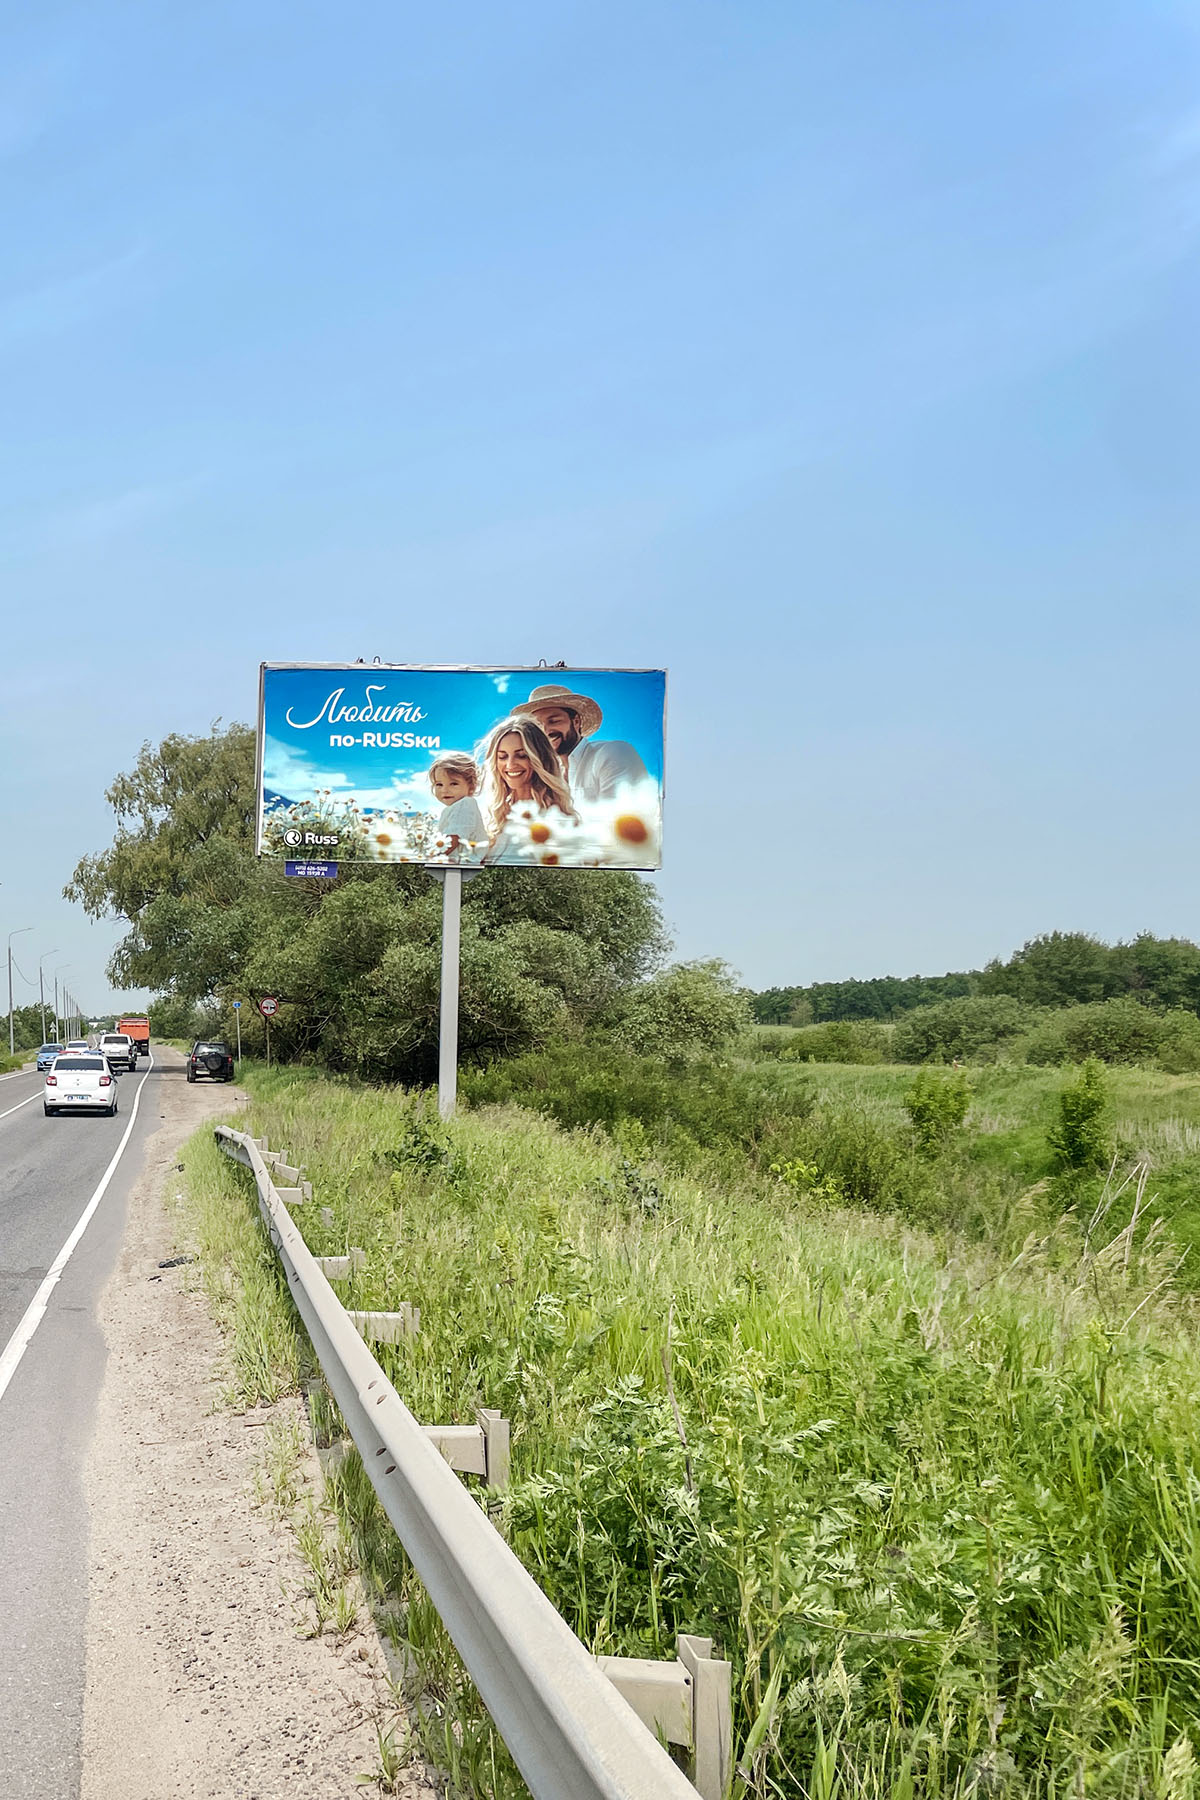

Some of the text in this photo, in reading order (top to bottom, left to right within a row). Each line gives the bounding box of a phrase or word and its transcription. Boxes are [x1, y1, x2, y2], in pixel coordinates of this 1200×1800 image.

[286, 685, 428, 729] Любить
[329, 732, 441, 749] по-RUSSки
[304, 832, 339, 845] Russ
